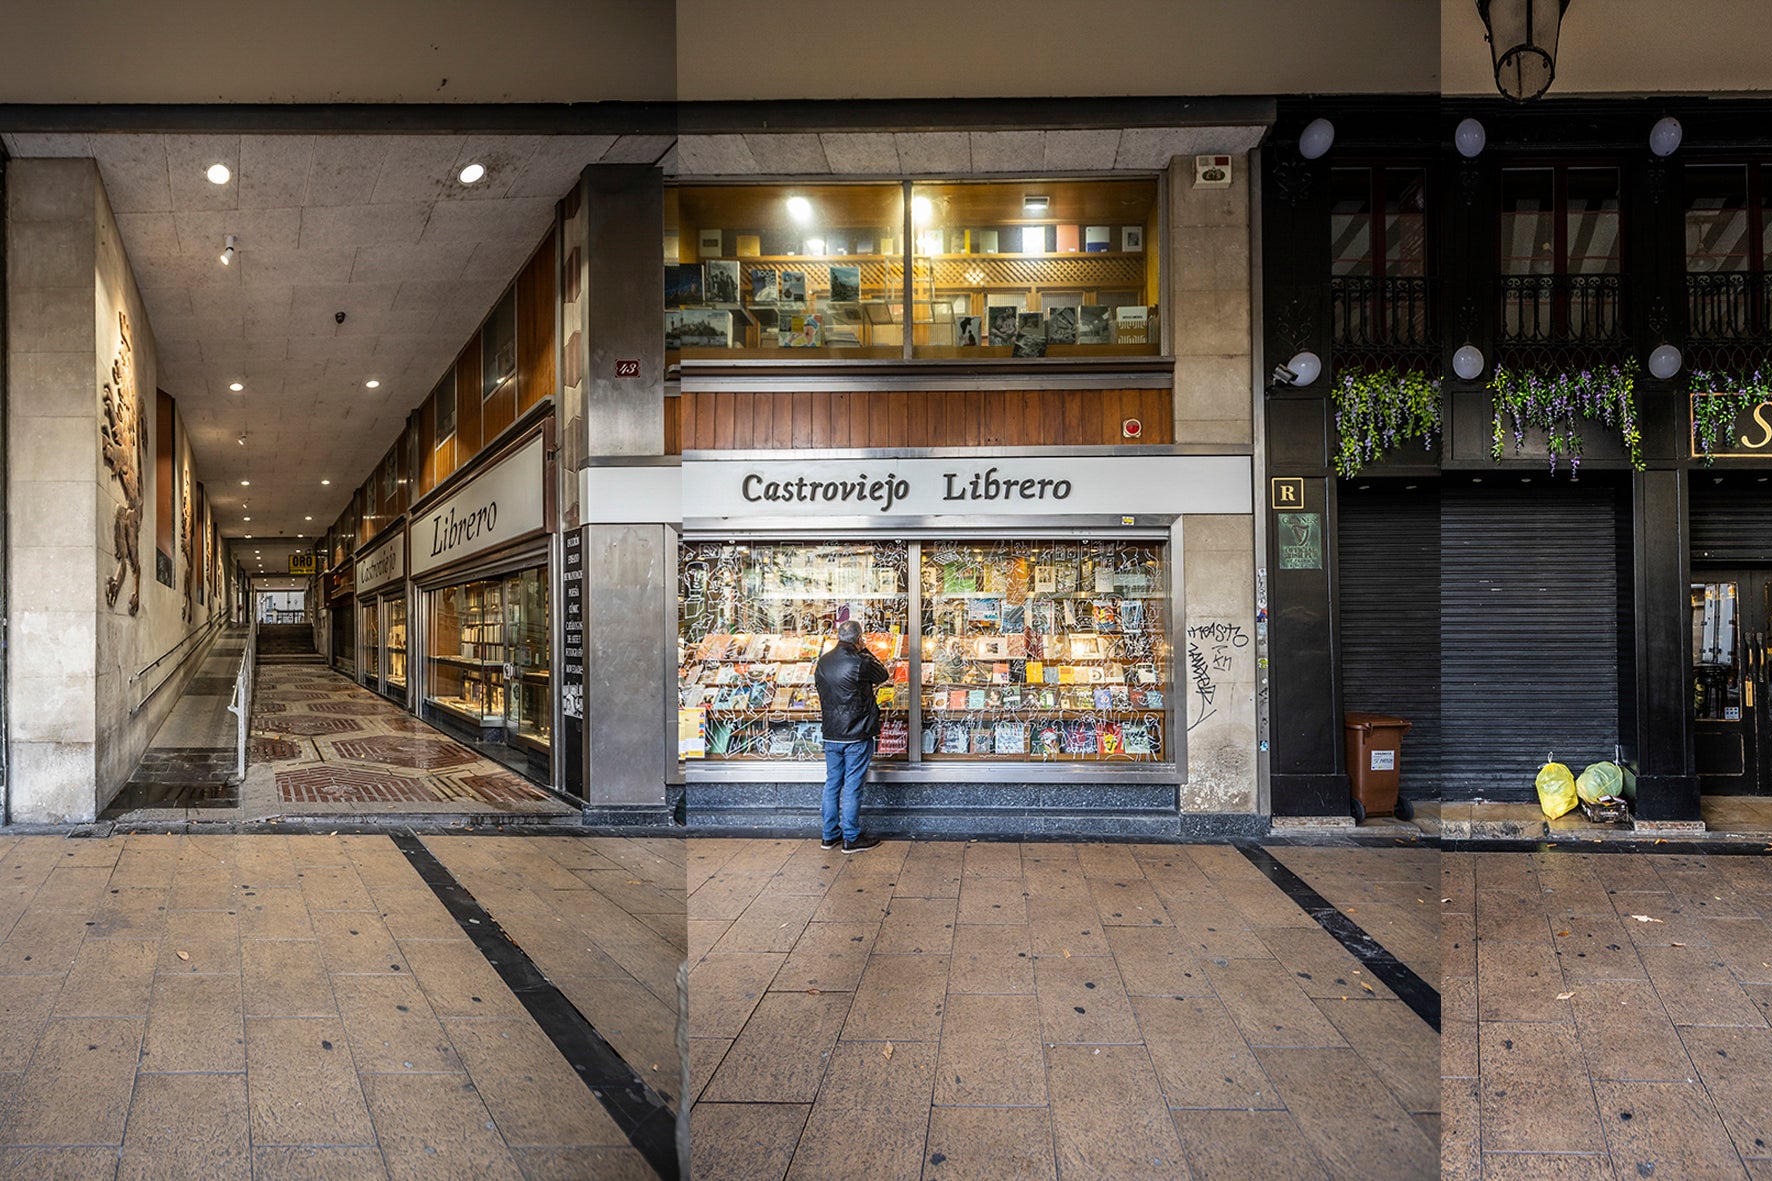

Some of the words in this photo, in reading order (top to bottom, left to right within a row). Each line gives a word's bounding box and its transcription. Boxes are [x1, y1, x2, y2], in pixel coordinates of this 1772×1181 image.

[619, 363, 637, 375] 43
[742, 473, 910, 512] Castroviejo
[943, 467, 1073, 501] Librero
[1280, 485, 1296, 501] R
[431, 501, 498, 557] Librero
[292, 556, 313, 567] ORO
[360, 545, 397, 584] Castroviejo
